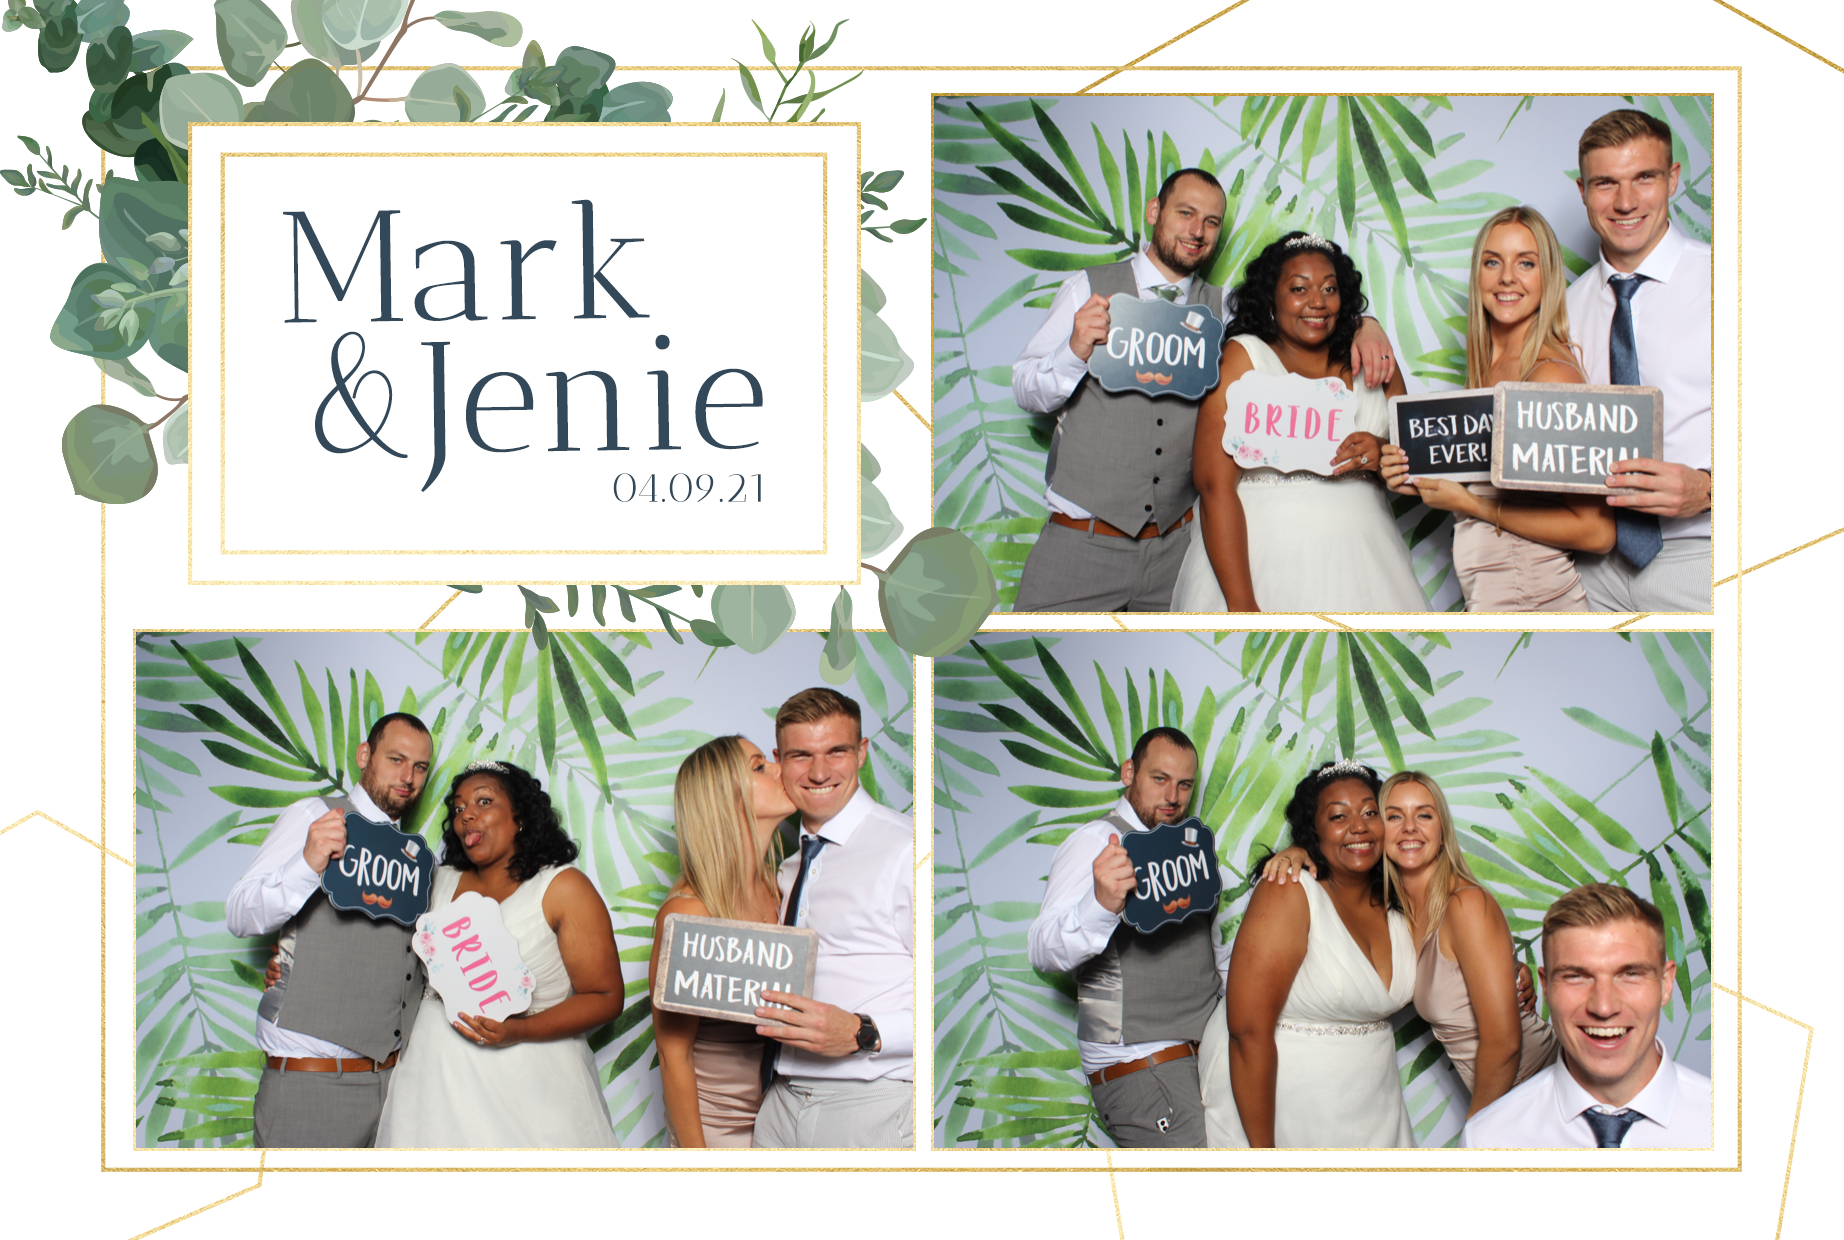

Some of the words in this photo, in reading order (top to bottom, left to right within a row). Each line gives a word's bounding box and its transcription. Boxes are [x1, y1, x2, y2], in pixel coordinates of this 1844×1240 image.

[1106, 326, 1206, 369] GROOM
[1244, 402, 1343, 442] BRIDE
[1408, 414, 1458, 439] BEST
[1517, 400, 1638, 434] HUSBAND
[1429, 442, 1488, 465] EVER!
[339, 844, 420, 897] GROOM
[1133, 849, 1210, 902] GROOM
[442, 916, 512, 1014] BRIDE
[682, 931, 794, 970] HUSBAND
